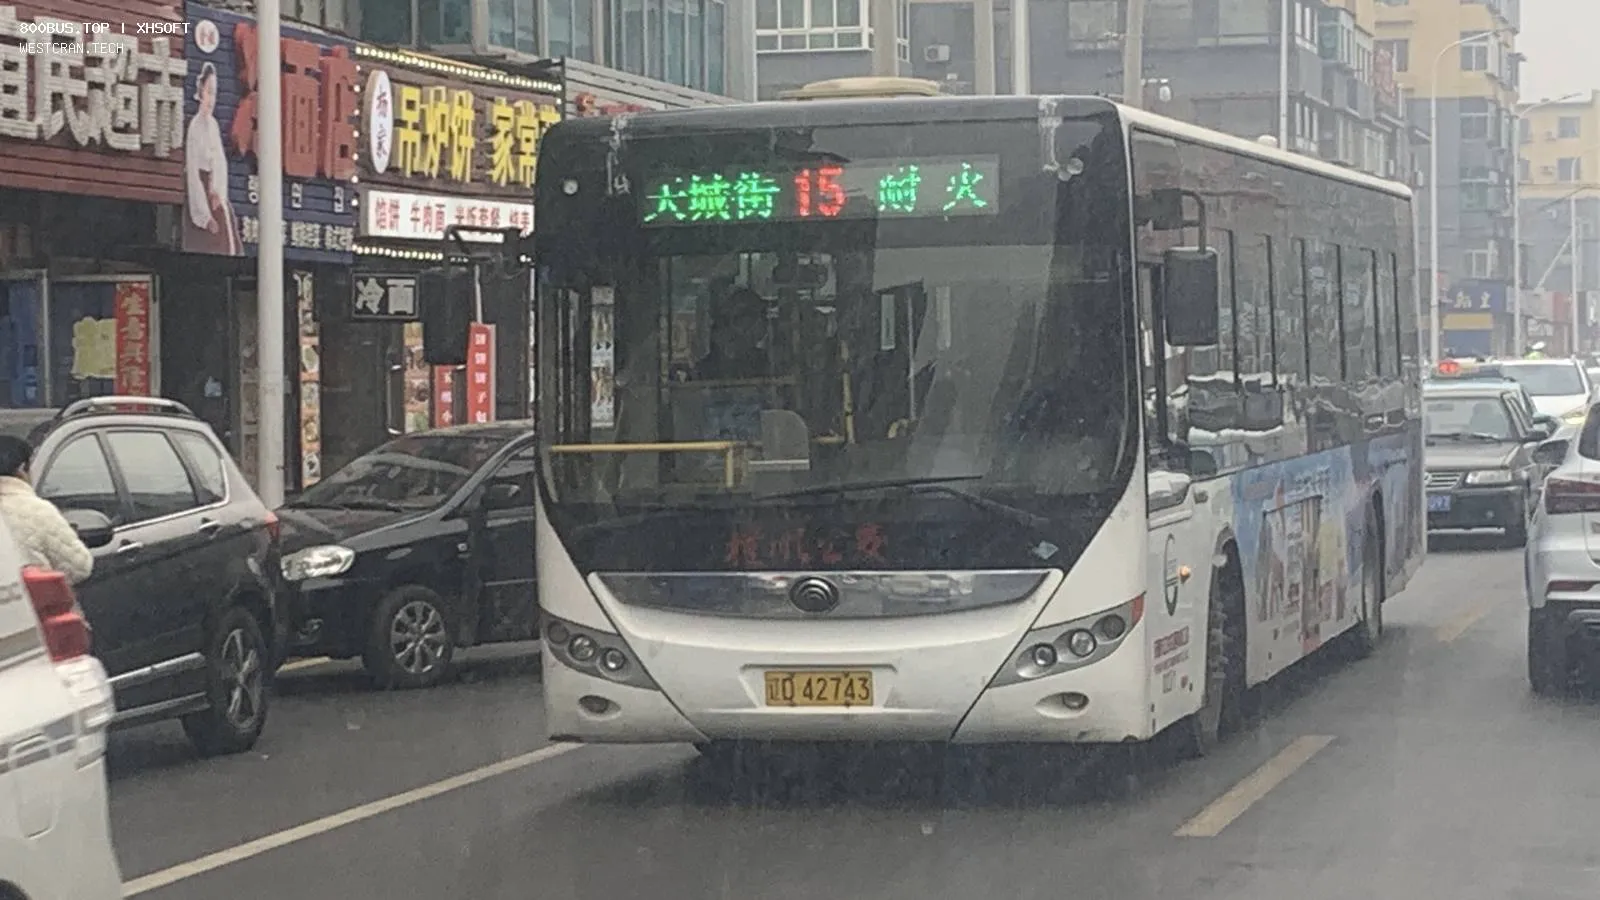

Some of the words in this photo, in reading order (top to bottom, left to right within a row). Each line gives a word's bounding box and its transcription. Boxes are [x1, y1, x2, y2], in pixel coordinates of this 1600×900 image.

[398, 86, 475, 183] 吊炉饼
[794, 166, 845, 216] 15
[355, 277, 416, 314] 冷面
